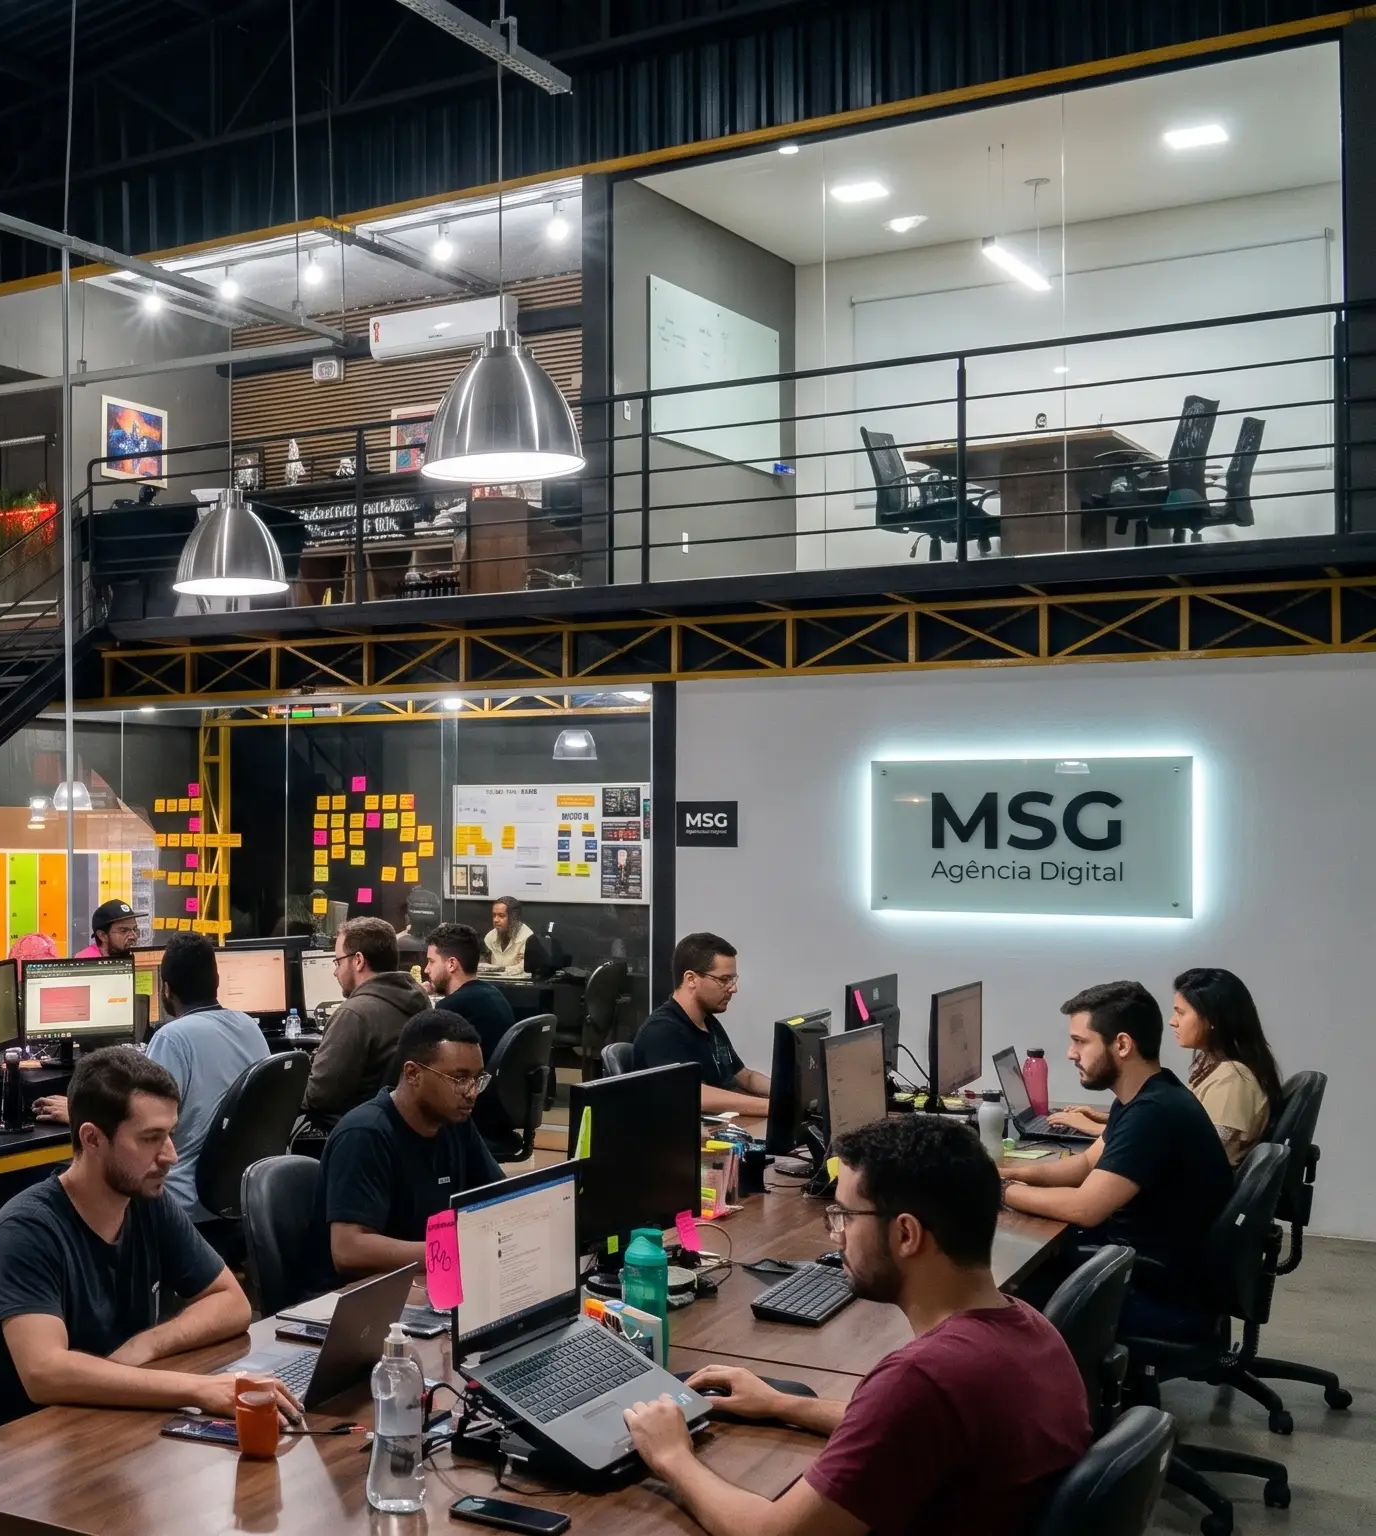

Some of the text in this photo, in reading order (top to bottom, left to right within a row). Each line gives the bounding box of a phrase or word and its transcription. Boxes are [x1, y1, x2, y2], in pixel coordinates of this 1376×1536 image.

[685, 812, 728, 828] MSG
[931, 790, 1123, 852] MSG
[931, 860, 1123, 886] Agência Digital
